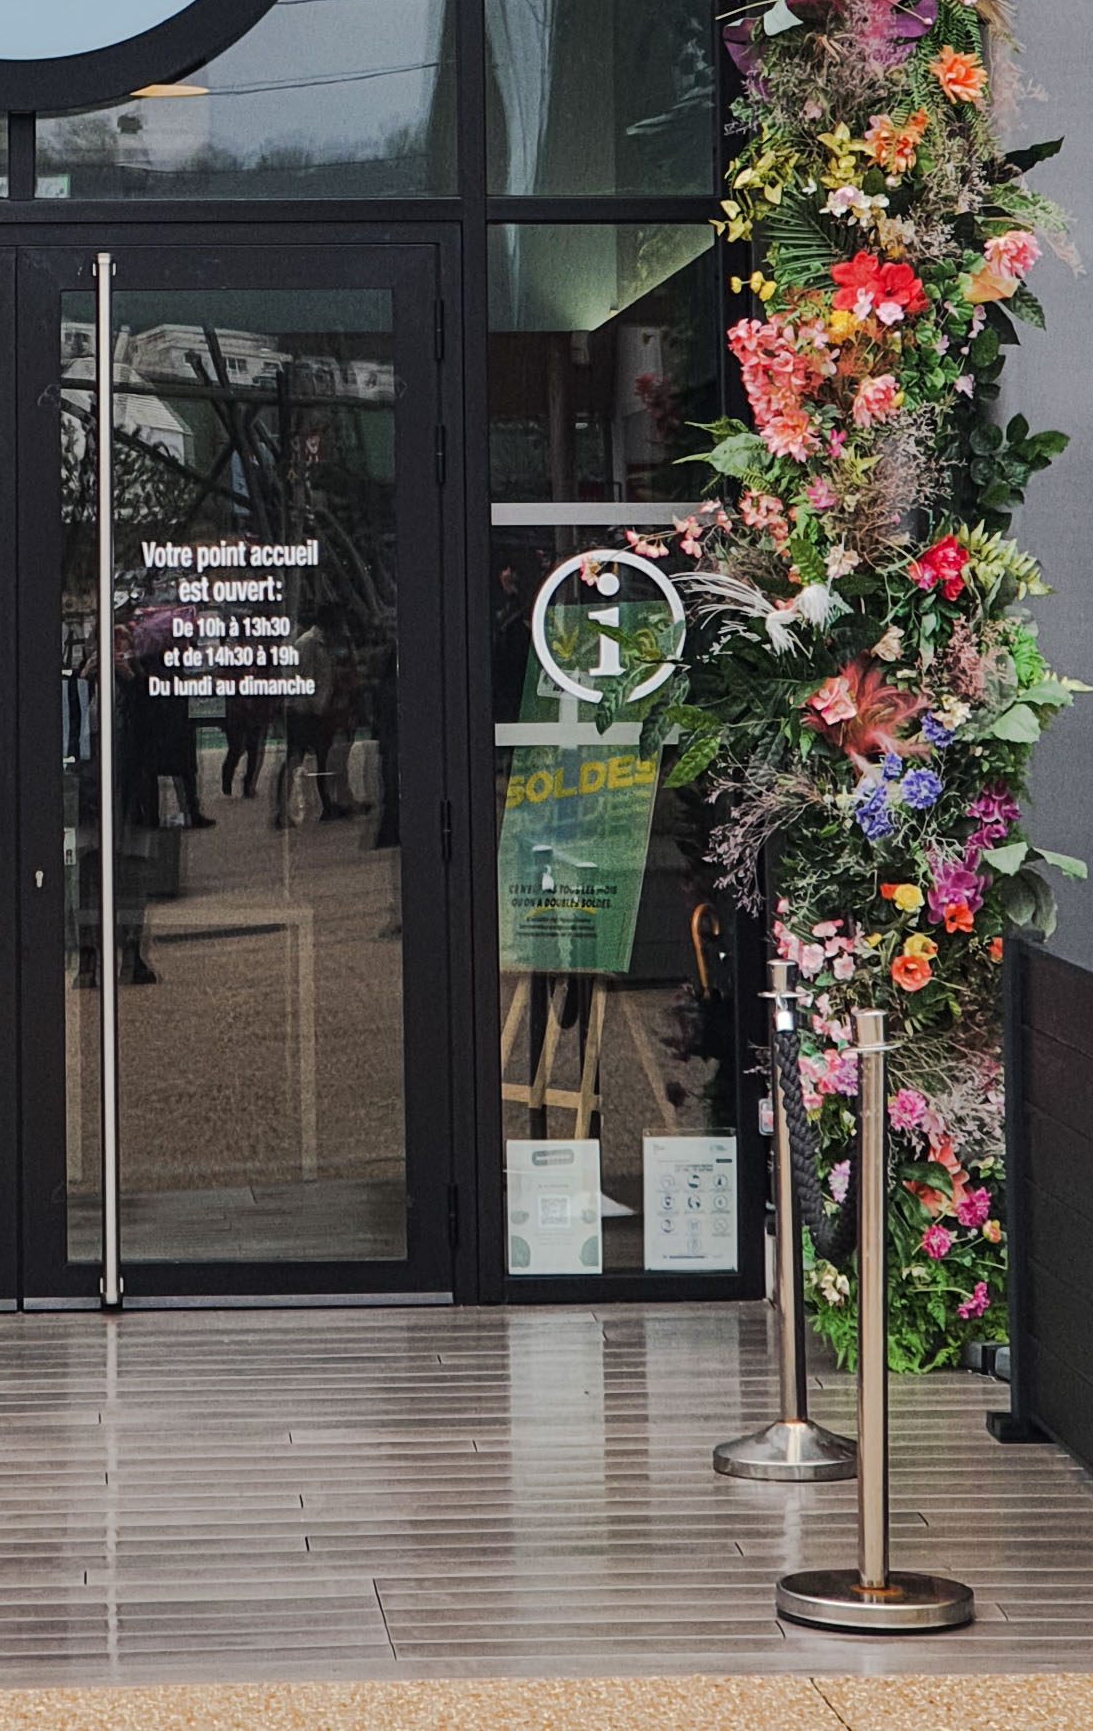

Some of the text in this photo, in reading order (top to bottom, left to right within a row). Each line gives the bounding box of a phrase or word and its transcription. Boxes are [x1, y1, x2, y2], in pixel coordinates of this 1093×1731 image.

[141, 539, 319, 573] Votre point accueil
[178, 576, 210, 603] est
[172, 615, 291, 638] De 10h à 13h30
[163, 645, 299, 667] et de 14h30 à 19h
[149, 674, 315, 696] Du lundi au dimanche
